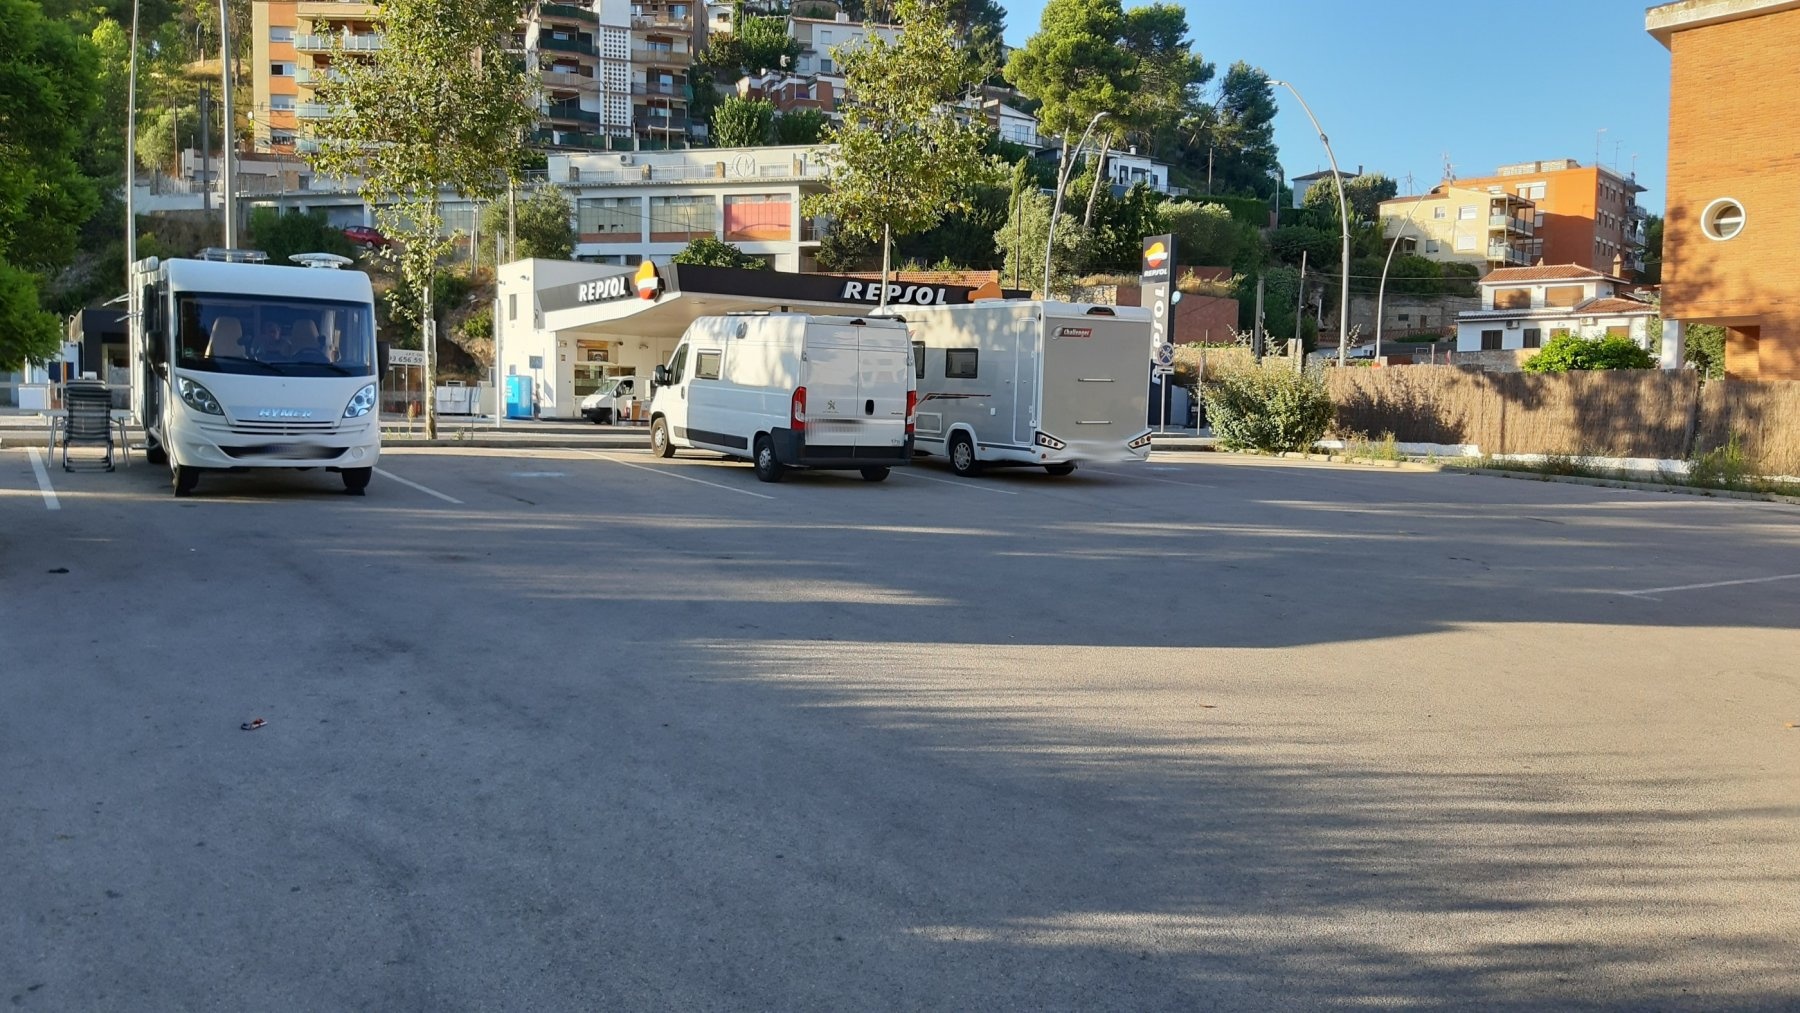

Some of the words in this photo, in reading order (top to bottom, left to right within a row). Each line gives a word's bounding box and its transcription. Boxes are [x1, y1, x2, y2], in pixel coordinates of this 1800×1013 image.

[1144, 268, 1167, 277] REPSOL
[579, 277, 625, 301] REPSOL
[843, 281, 946, 304] REPSOL
[259, 408, 313, 417] HYMER
